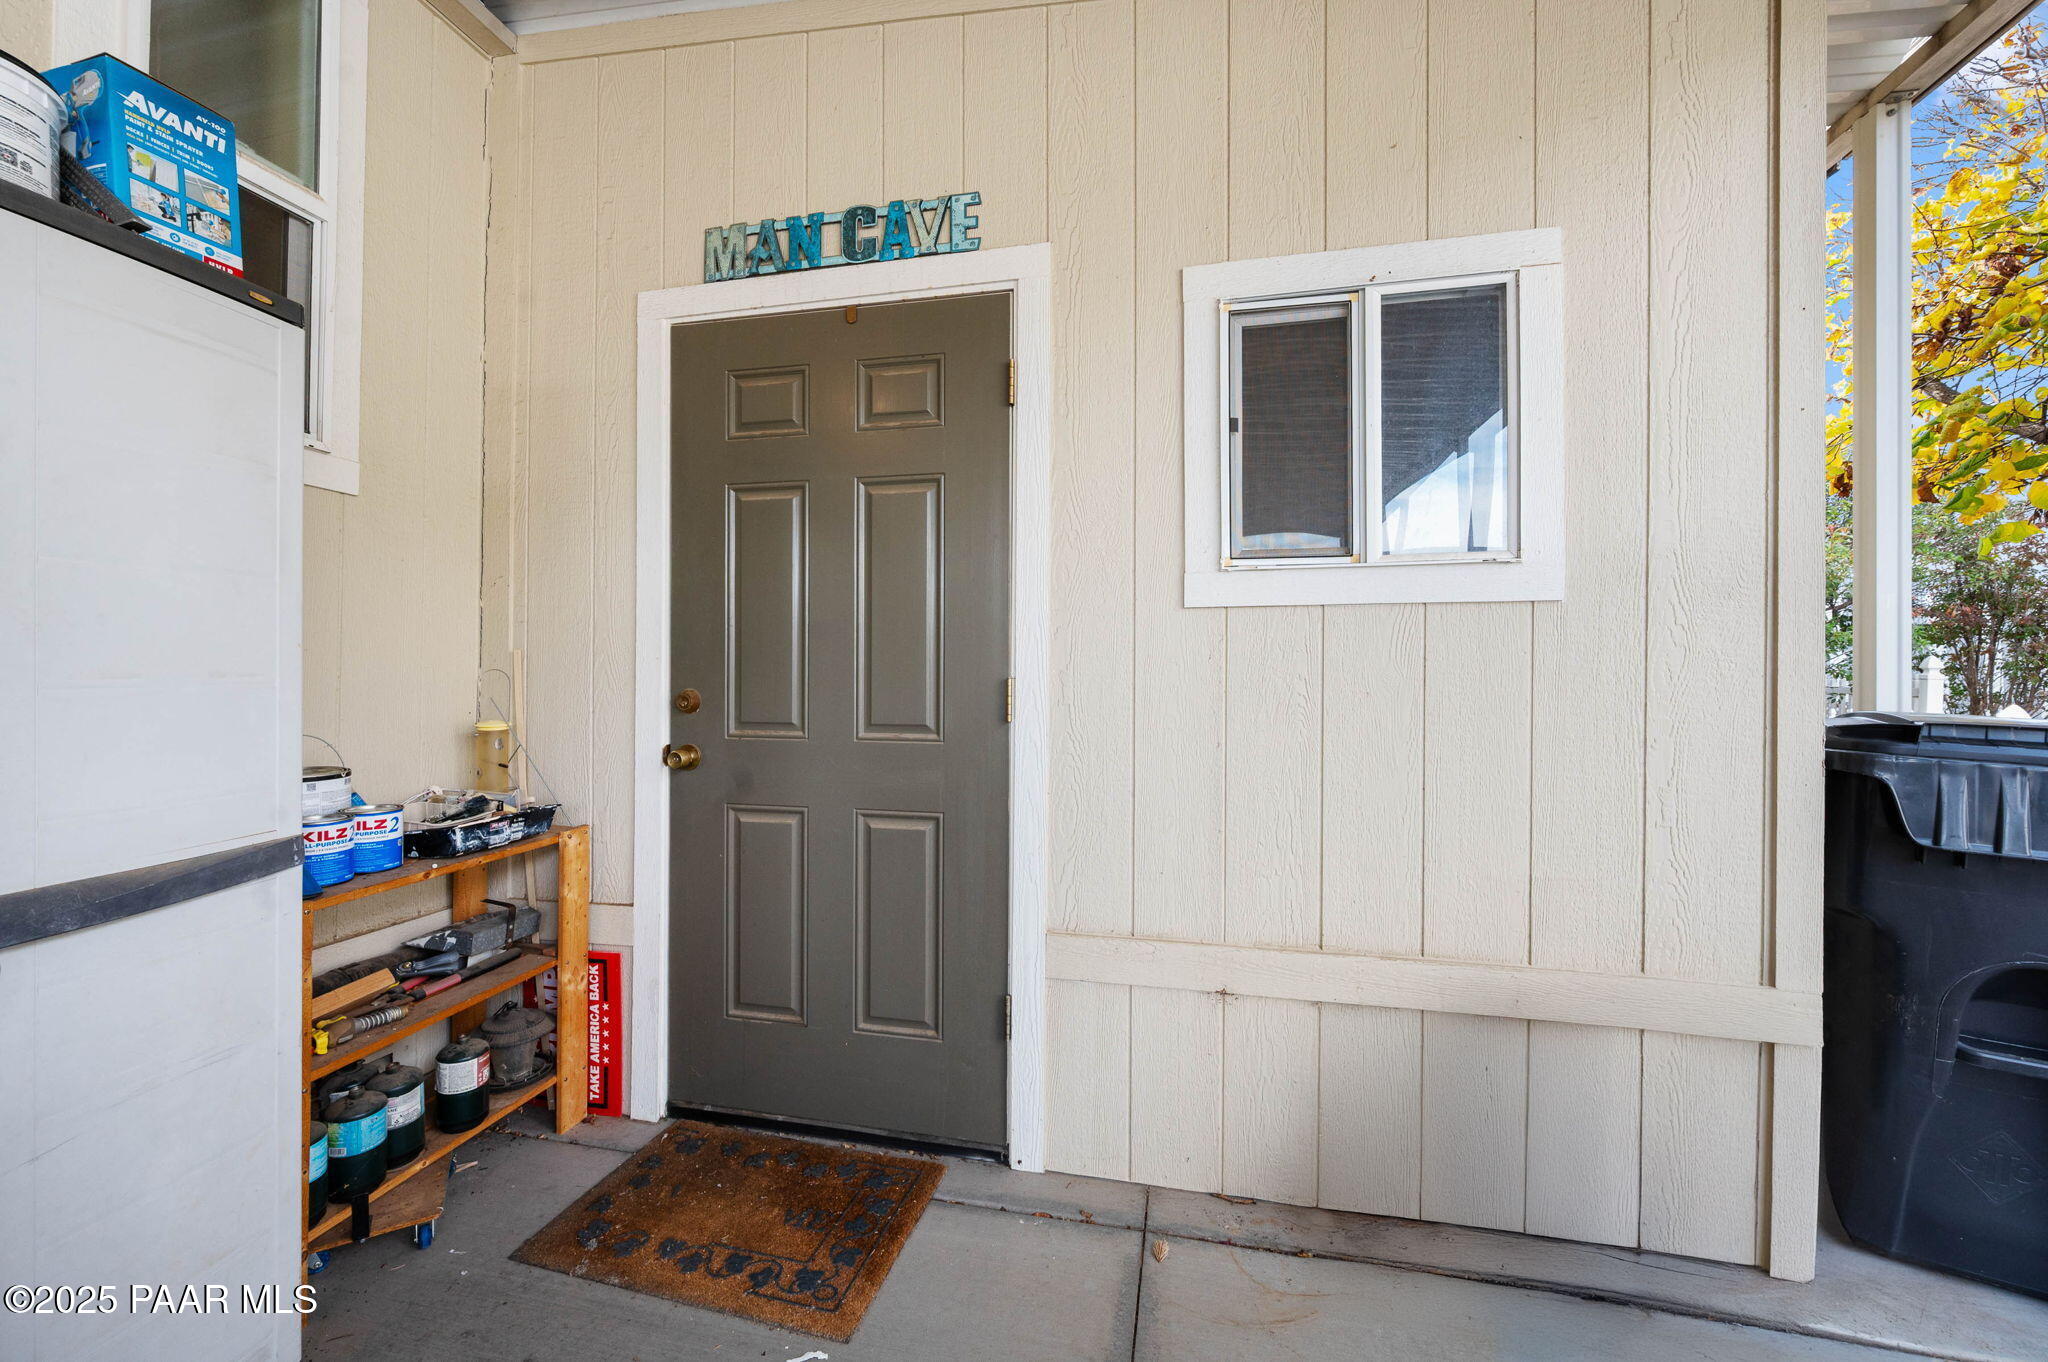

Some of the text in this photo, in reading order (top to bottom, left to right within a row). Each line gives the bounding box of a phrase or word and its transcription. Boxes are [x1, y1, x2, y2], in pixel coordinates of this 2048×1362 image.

[119, 90, 226, 154] AVANTI
[125, 125, 144, 137] DECKS
[124, 114, 146, 128] PAINT
[155, 129, 174, 142] STAIN
[175, 139, 204, 157] SPRAYER
[704, 191, 982, 283] MAN CAVE
[355, 829, 388, 837] PURPOSE
[356, 816, 399, 834] ILZ 2
[303, 827, 348, 843] KILZ
[305, 839, 348, 849] LL-PURPOSE
[588, 964, 600, 1101] TAKE AMERICA BACK
